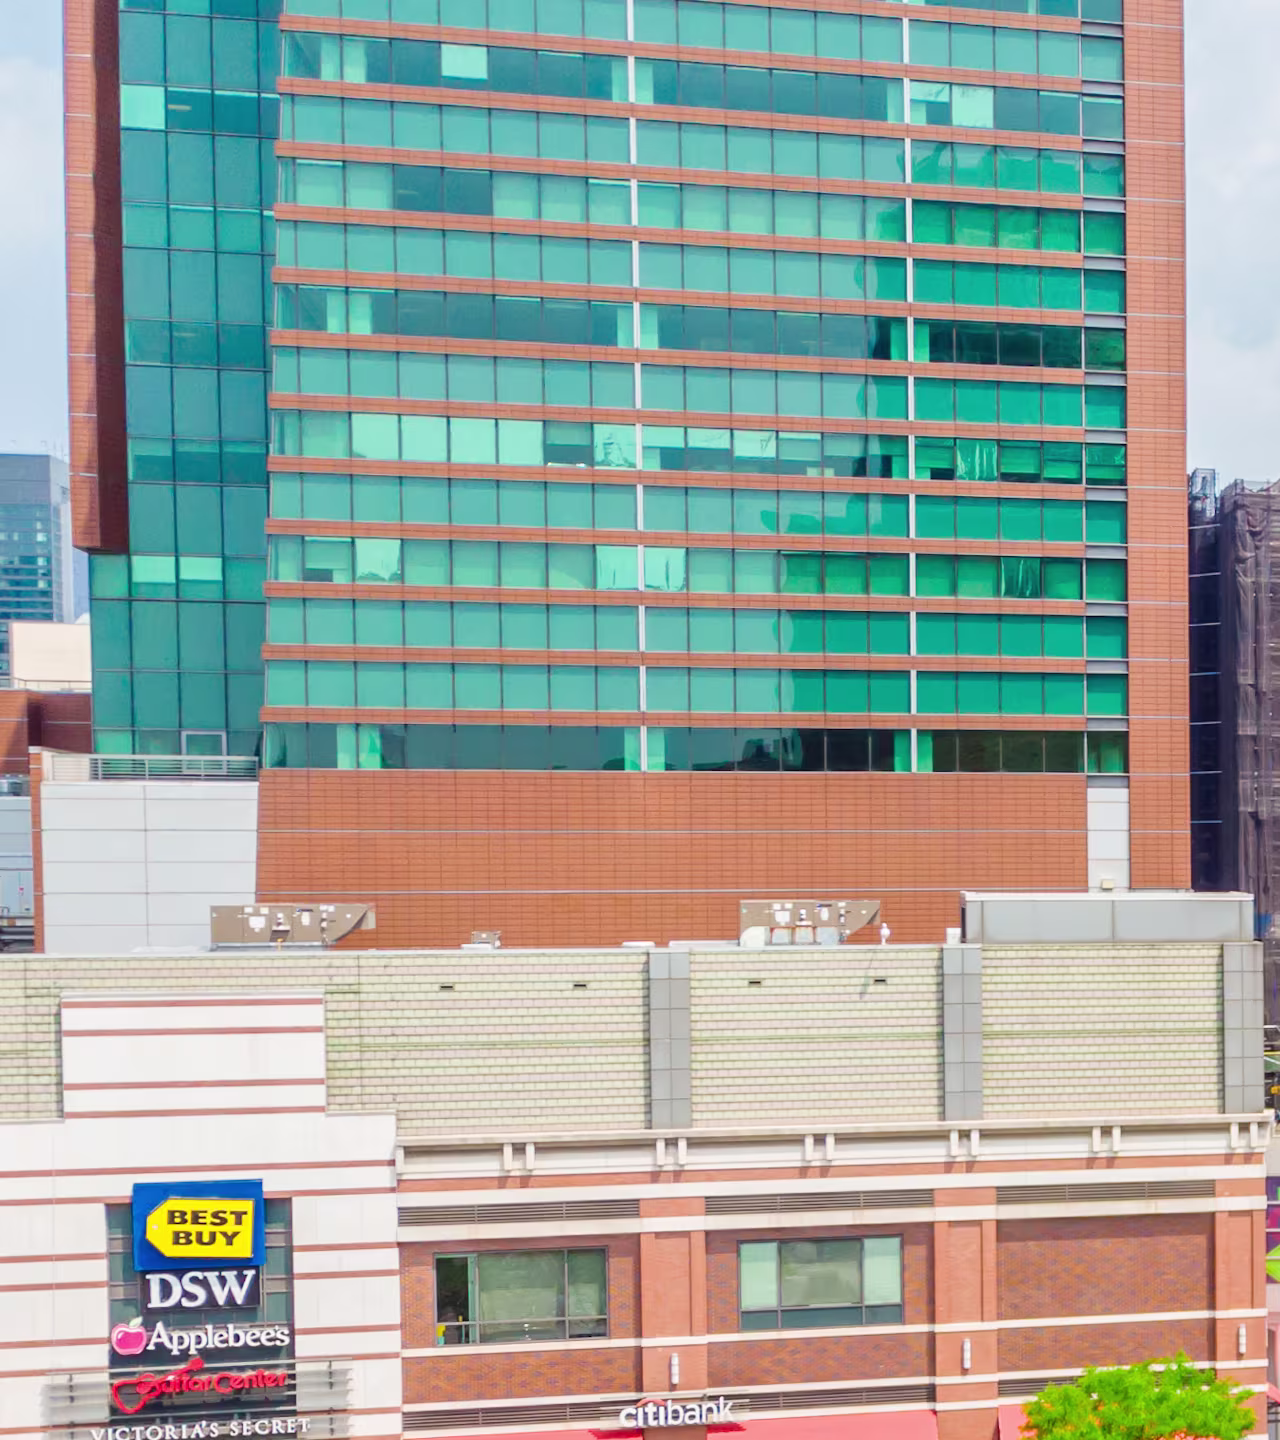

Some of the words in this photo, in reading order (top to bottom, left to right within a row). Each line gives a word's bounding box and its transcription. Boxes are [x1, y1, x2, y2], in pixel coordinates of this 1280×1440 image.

[167, 1210, 248, 1226] BEST
[172, 1231, 241, 1246] BUY
[145, 1270, 256, 1308] DSW
[146, 1321, 290, 1355] Applebee's
[214, 1369, 287, 1393] Center
[619, 1396, 733, 1428] citibank
[230, 1418, 311, 1436] SECRET
